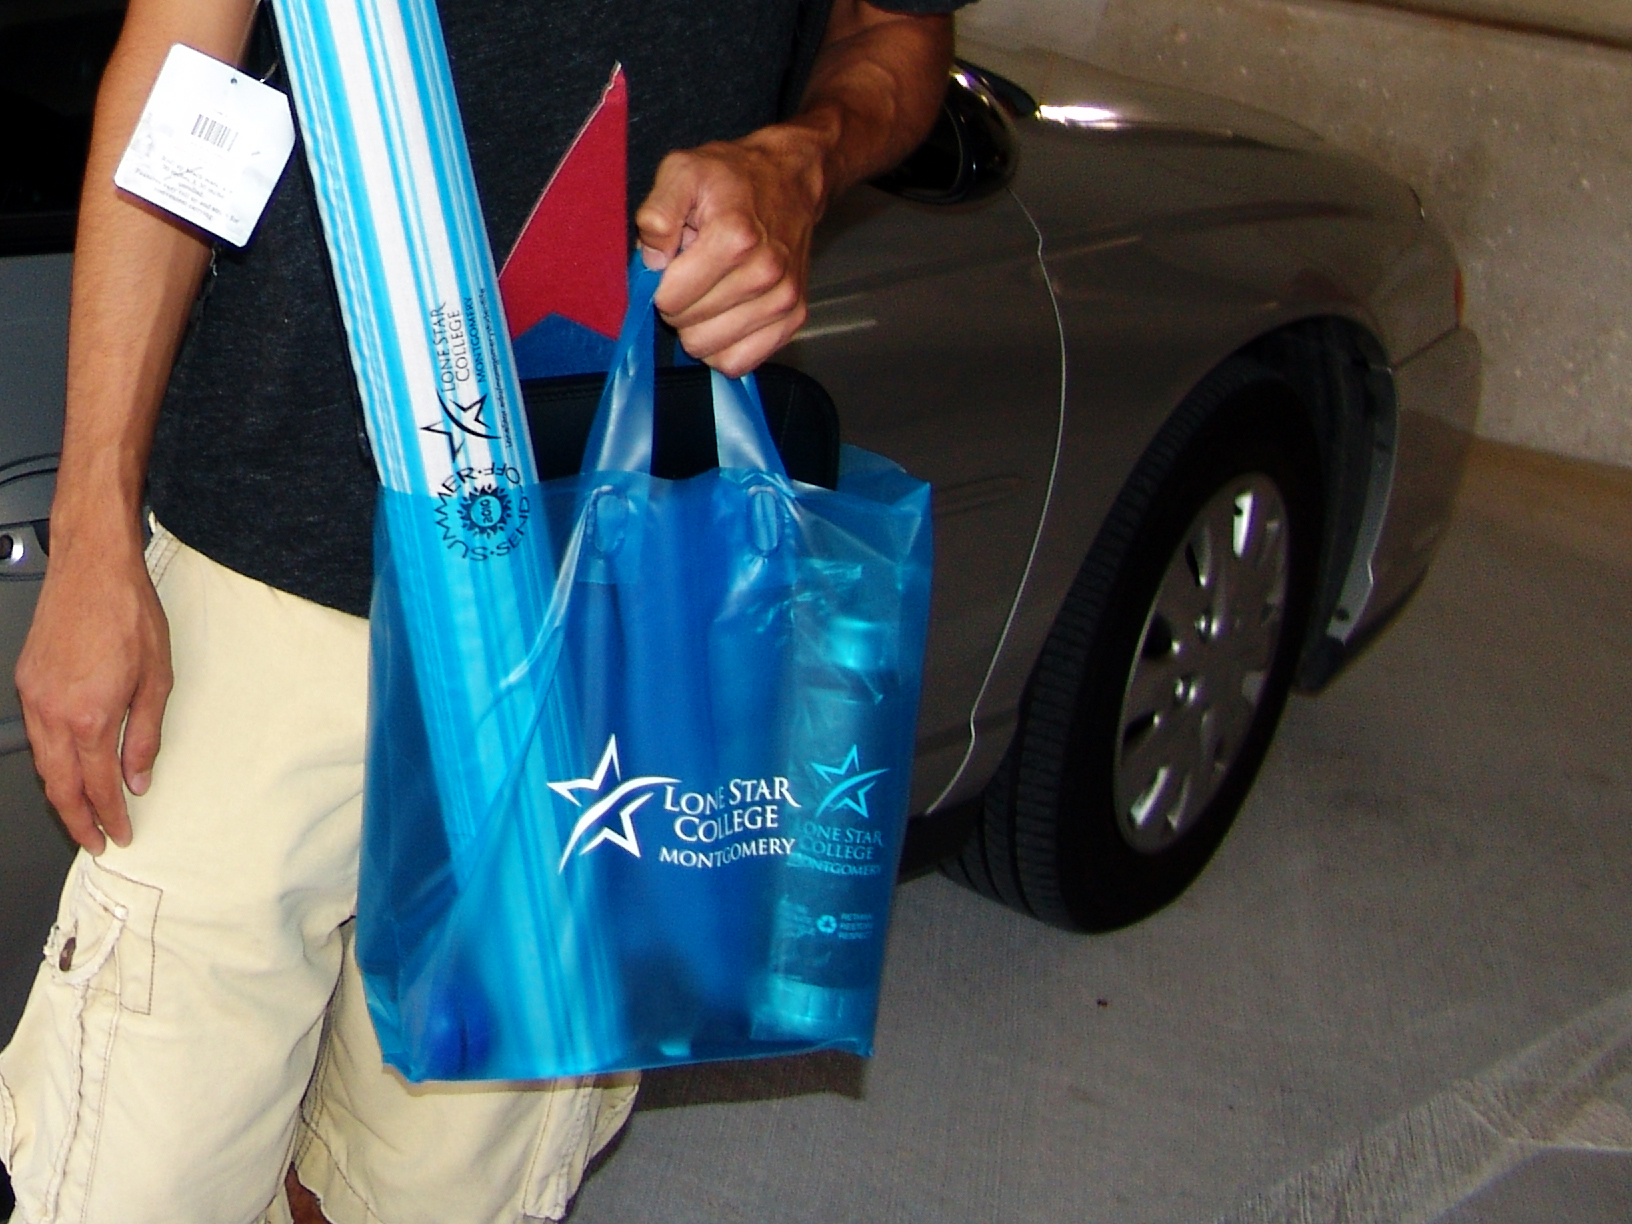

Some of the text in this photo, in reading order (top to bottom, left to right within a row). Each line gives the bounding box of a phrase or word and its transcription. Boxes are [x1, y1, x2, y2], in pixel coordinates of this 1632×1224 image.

[430, 301, 456, 392] LONE STAR
[447, 310, 470, 382] COLLEGE
[464, 297, 486, 384] MONTGOMERY
[434, 467, 488, 561] SUMMER
[480, 498, 494, 525] 2010
[664, 776, 802, 816] LONE STAR
[674, 805, 779, 843] COLLEGE
[844, 828, 884, 848] STAR
[659, 837, 796, 868] MONTGOMERY
